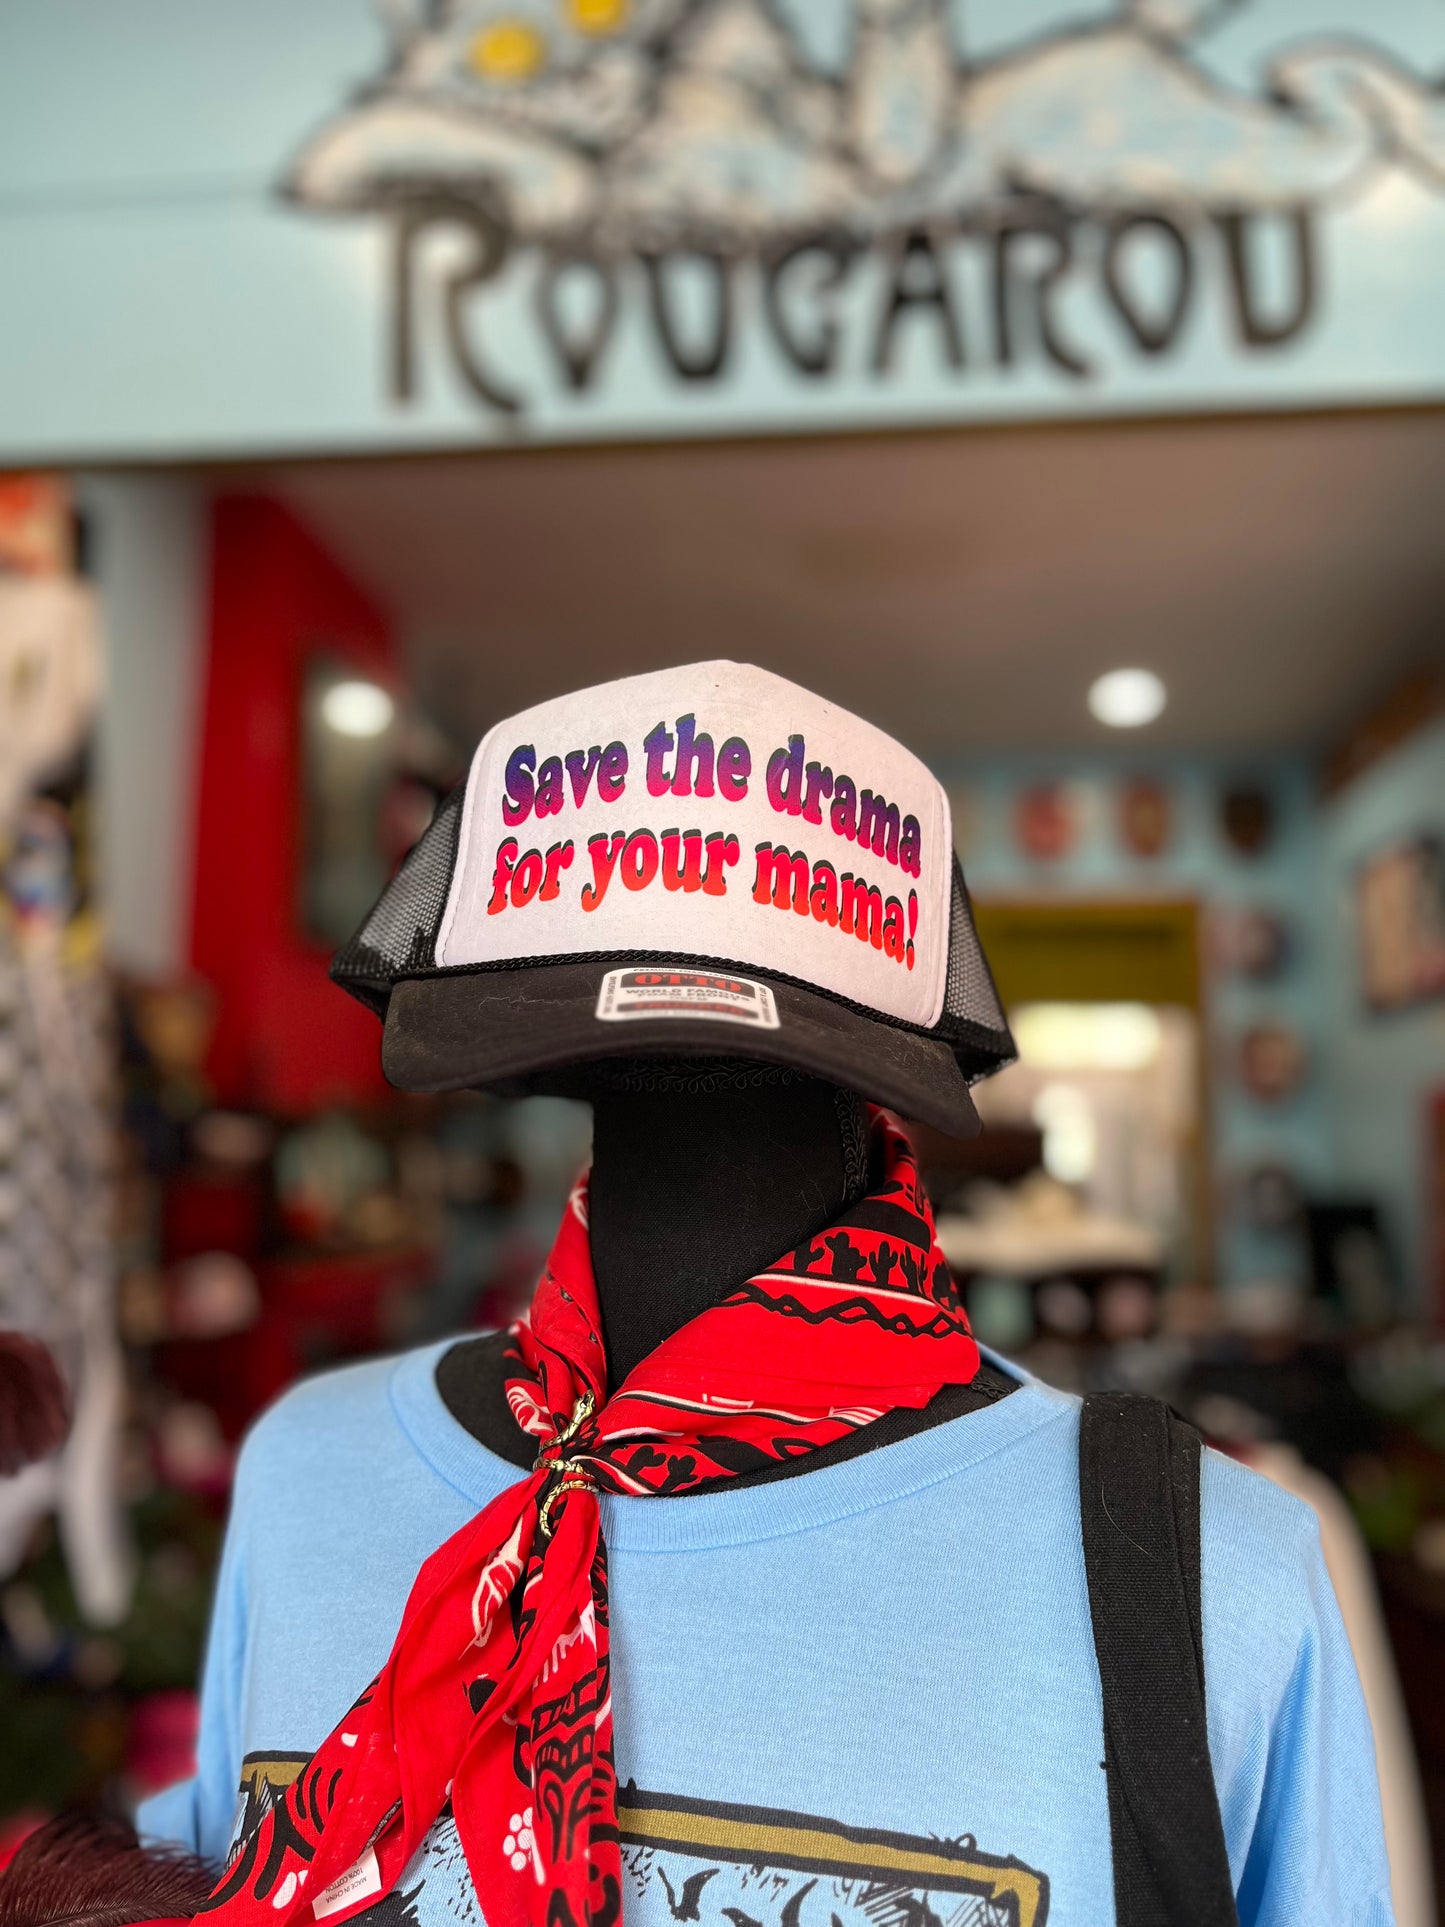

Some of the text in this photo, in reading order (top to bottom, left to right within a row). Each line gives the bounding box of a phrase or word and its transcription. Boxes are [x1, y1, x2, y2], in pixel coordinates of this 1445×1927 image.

[390, 184, 1320, 416] ROUGAROU
[502, 712, 922, 879] Save the drama
[487, 827, 918, 971] for your mama!
[634, 973, 742, 993] OTTO
[325, 1867, 364, 1894] 100% COTTON
[325, 1876, 367, 1904] MADE IN CHINA
